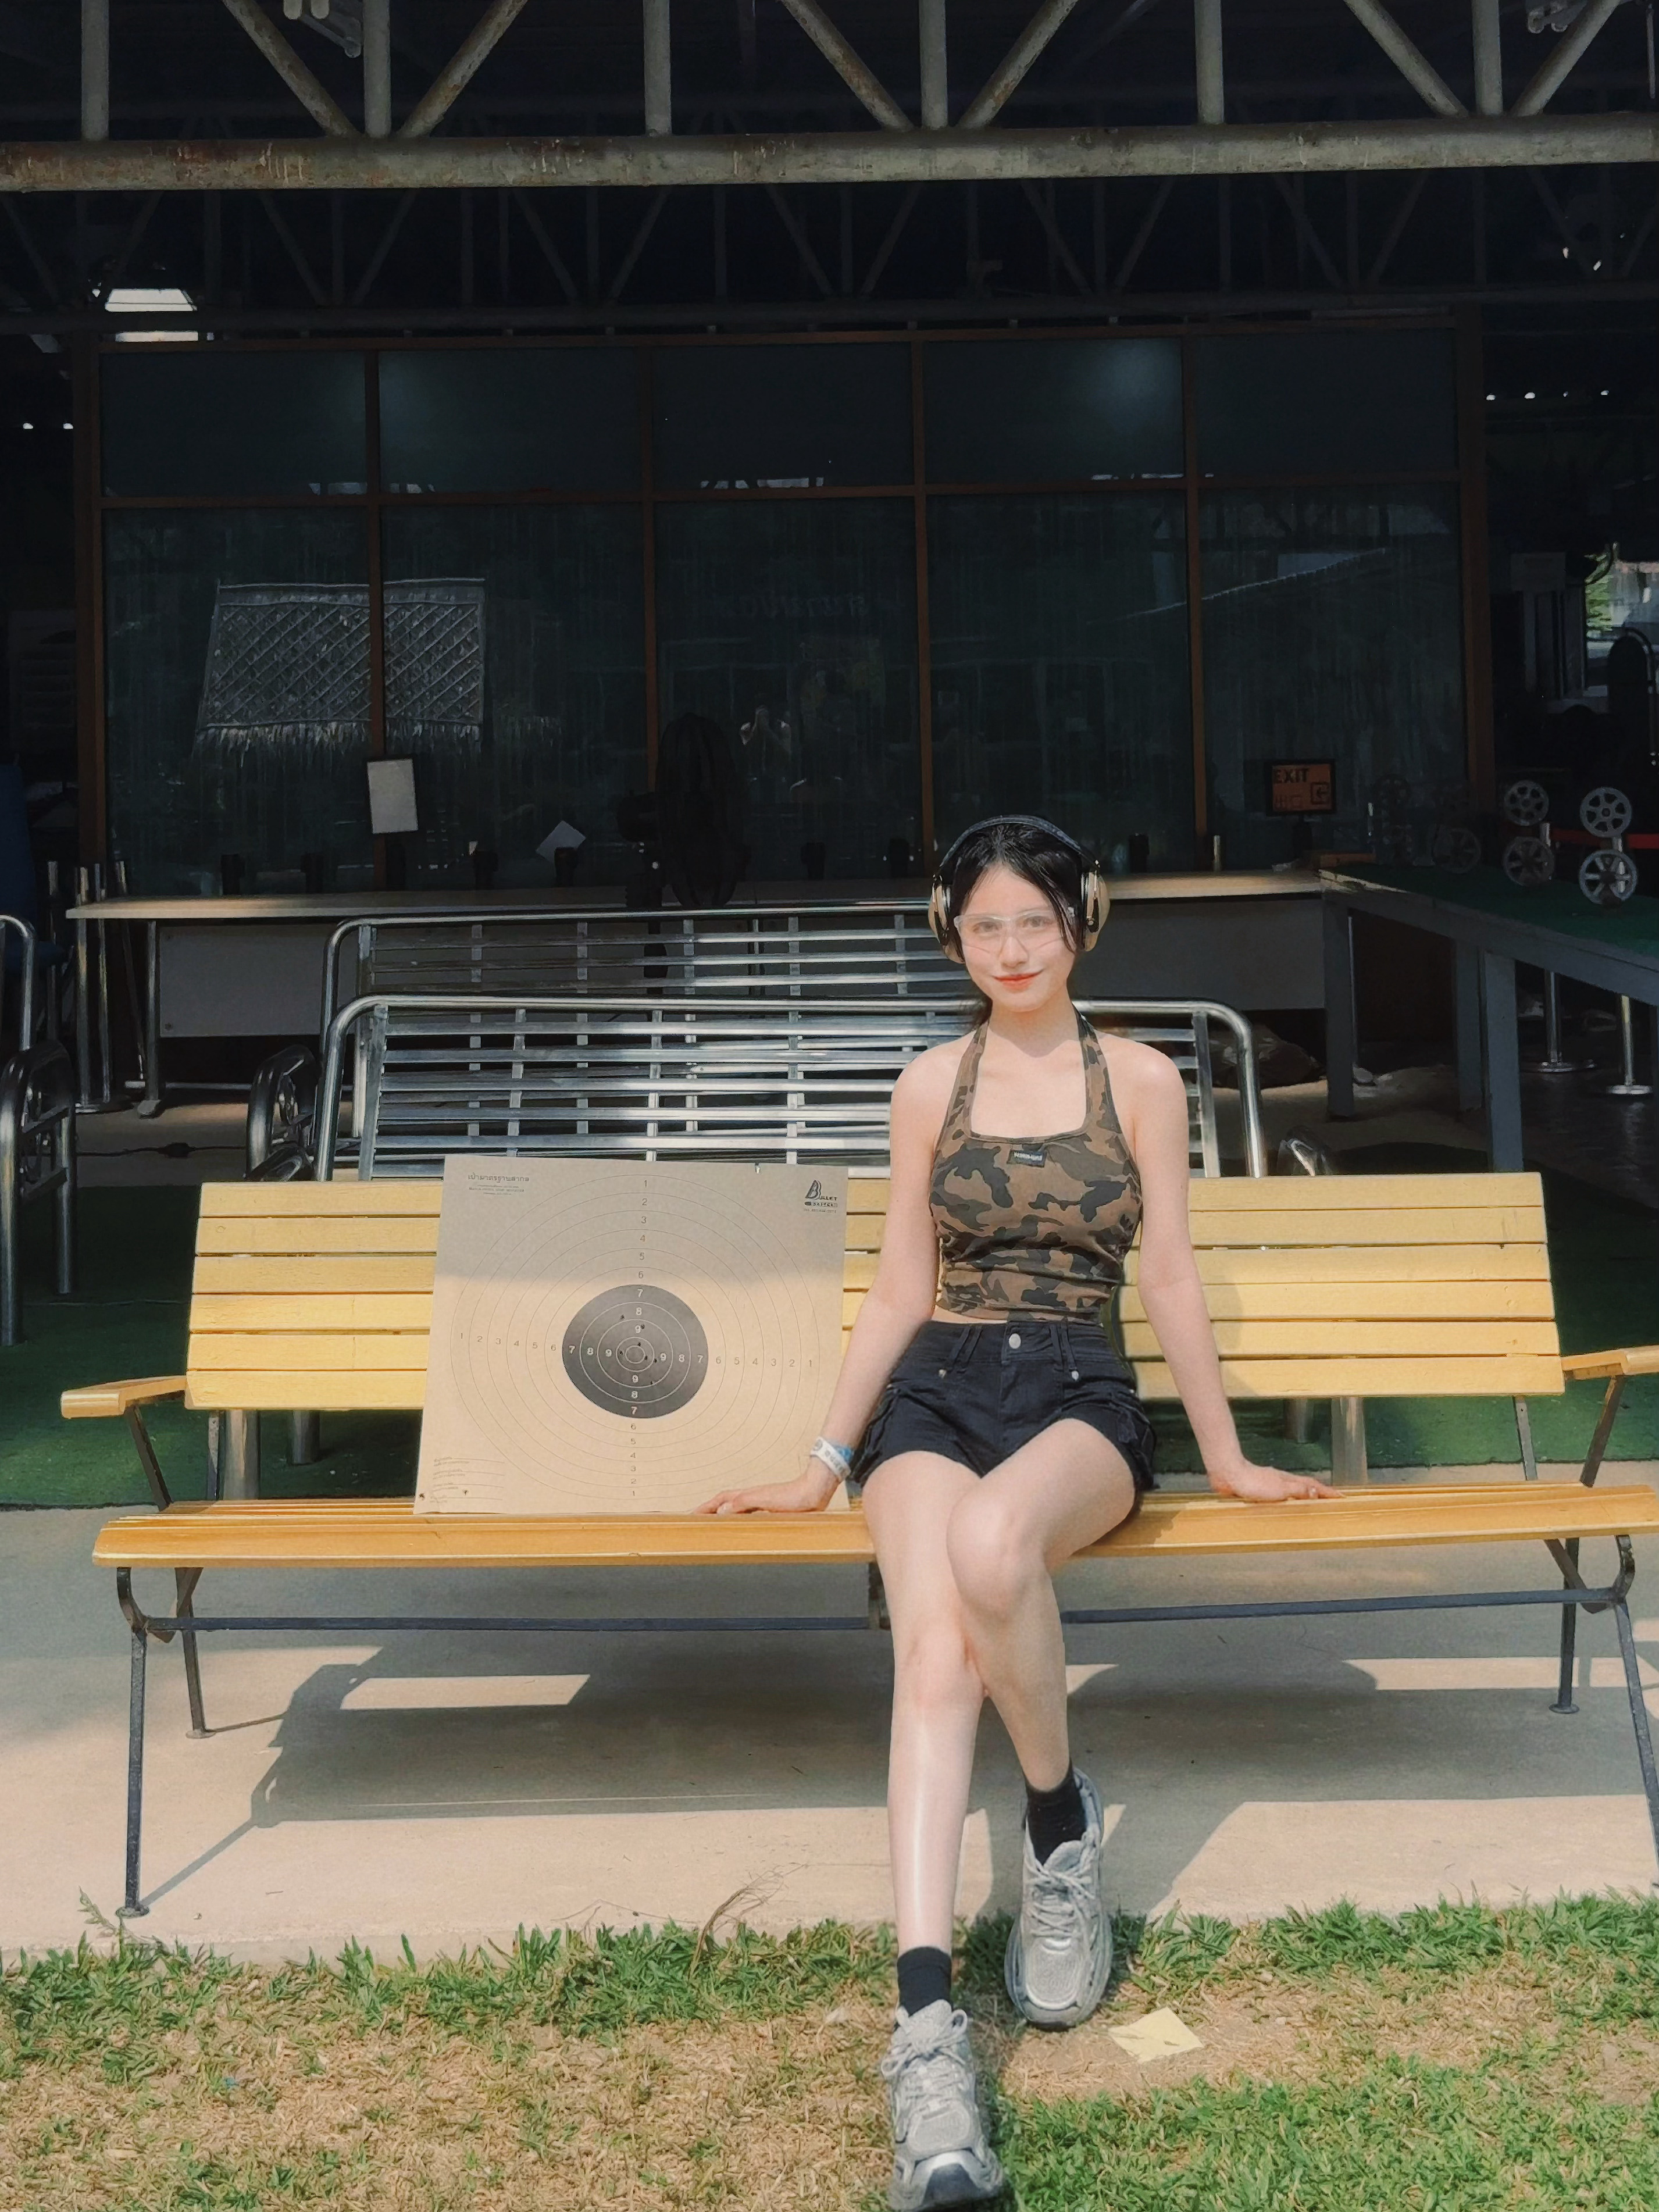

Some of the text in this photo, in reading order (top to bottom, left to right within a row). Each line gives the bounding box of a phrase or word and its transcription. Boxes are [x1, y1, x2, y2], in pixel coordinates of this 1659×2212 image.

[1273, 768, 1310, 783] EXIT
[641, 1198, 648, 1206] 2
[640, 1216, 647, 1224] 3
[639, 1235, 646, 1243] 4
[639, 1252, 645, 1261] 5
[638, 1271, 644, 1279] 6
[637, 1289, 644, 1298] 7
[636, 1307, 643, 1316] 8
[634, 1325, 641, 1333] 9
[513, 1339, 520, 1347] 4
[532, 1342, 538, 1350] 5
[569, 1345, 576, 1354] 7
[587, 1347, 594, 1355] 8
[605, 1348, 612, 1357] 9
[659, 1353, 667, 1361] 9
[679, 1354, 685, 1363] 8
[697, 1354, 704, 1364] 7
[715, 1355, 722, 1365] 6
[734, 1357, 740, 1366] 5
[752, 1357, 758, 1365] 4
[770, 1358, 777, 1367] 3
[789, 1358, 795, 1368] 2
[632, 1374, 639, 1383] 9
[631, 1390, 638, 1399] 8
[631, 1405, 638, 1415] 7
